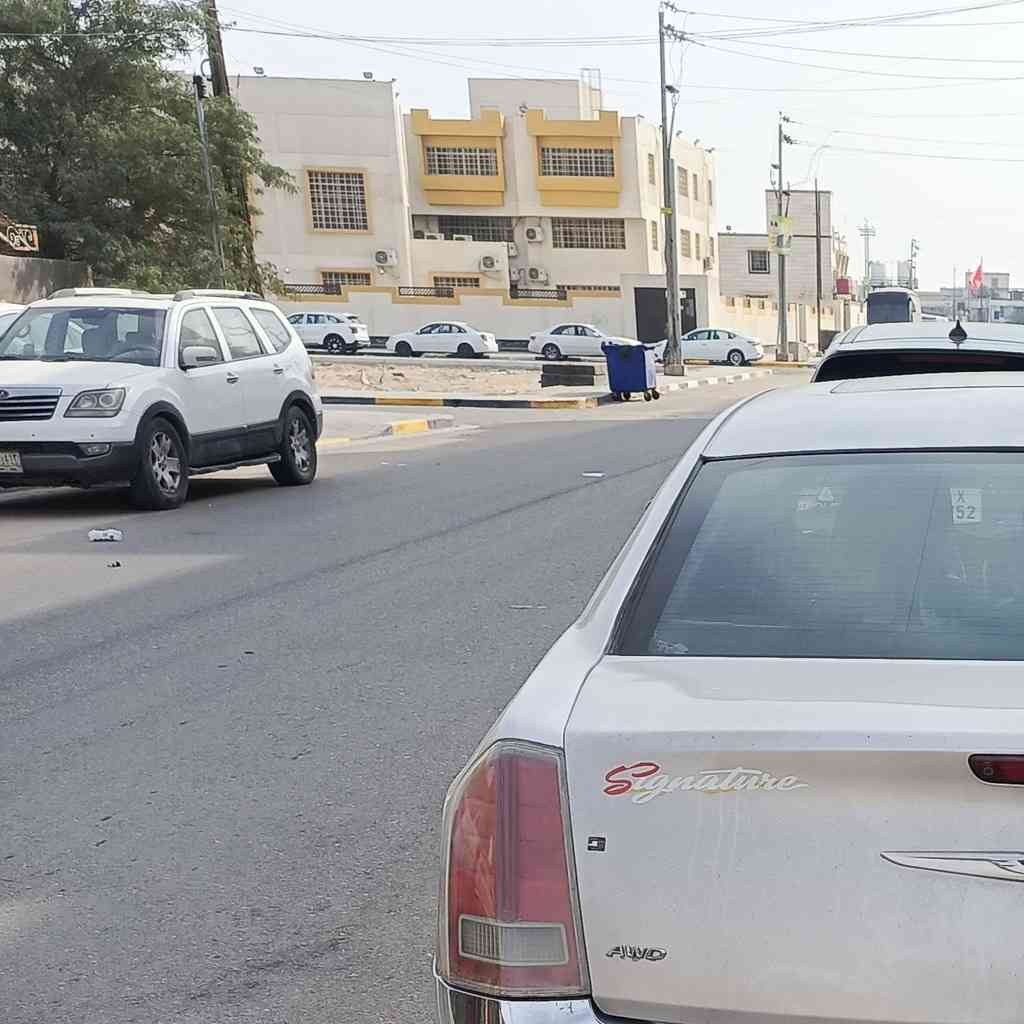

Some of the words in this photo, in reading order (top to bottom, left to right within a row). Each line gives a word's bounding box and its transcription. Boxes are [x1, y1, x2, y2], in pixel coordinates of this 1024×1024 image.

[956, 505, 976, 519] 52
[603, 762, 809, 804] Signature
[605, 944, 668, 961] AWD
